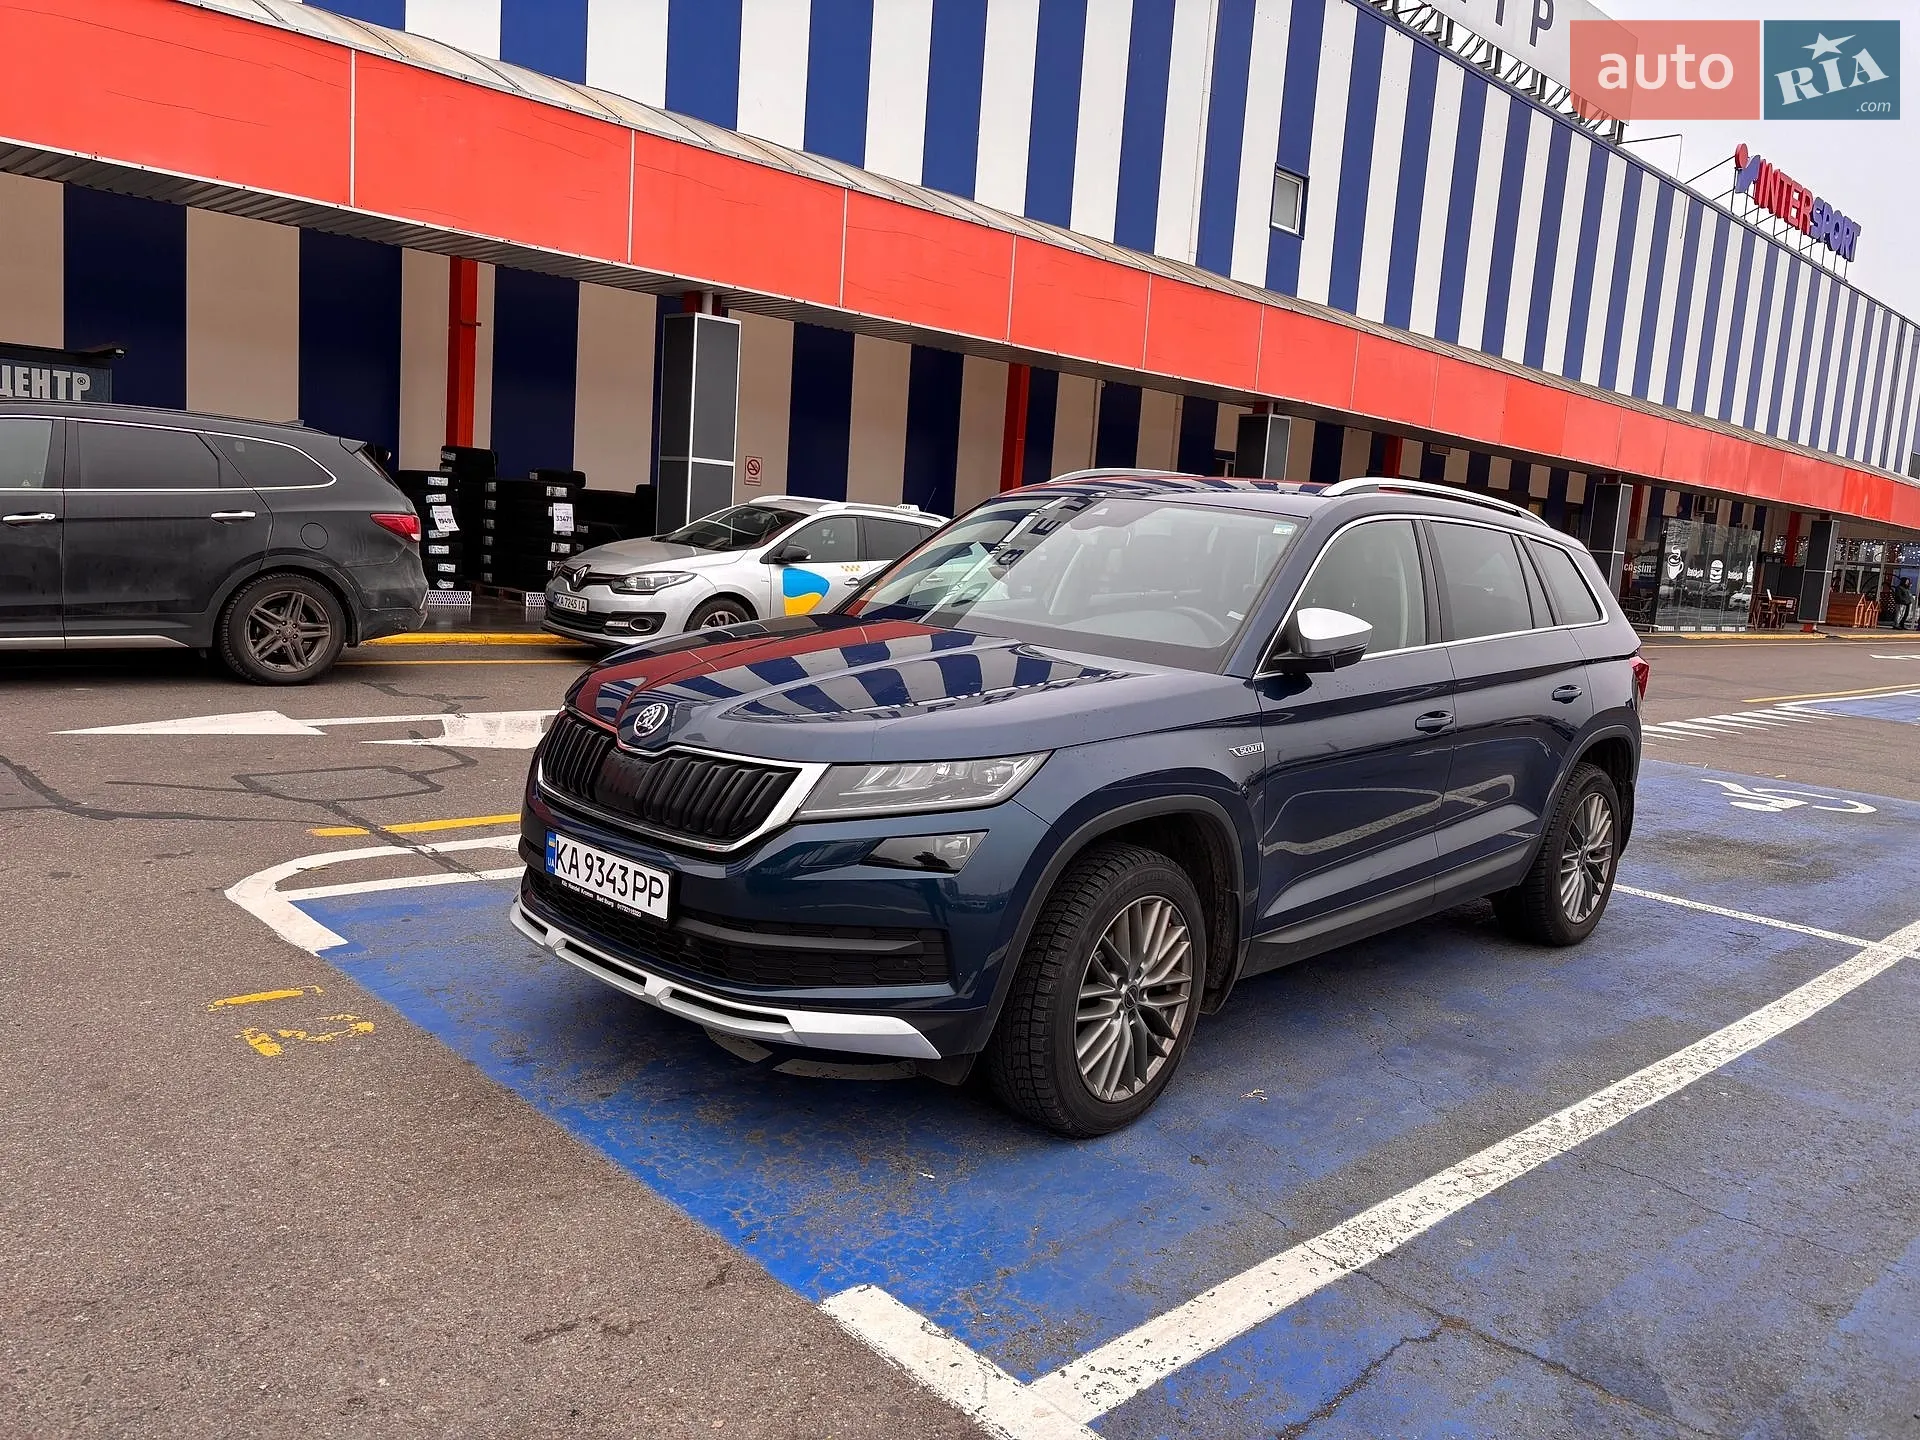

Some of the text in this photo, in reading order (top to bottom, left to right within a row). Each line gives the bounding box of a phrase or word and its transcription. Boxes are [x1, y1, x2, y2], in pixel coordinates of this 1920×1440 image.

[1753, 159, 1861, 262] INTERSPORT
[547, 858, 554, 868] UA
[555, 840, 664, 908] KA 9343 PP
